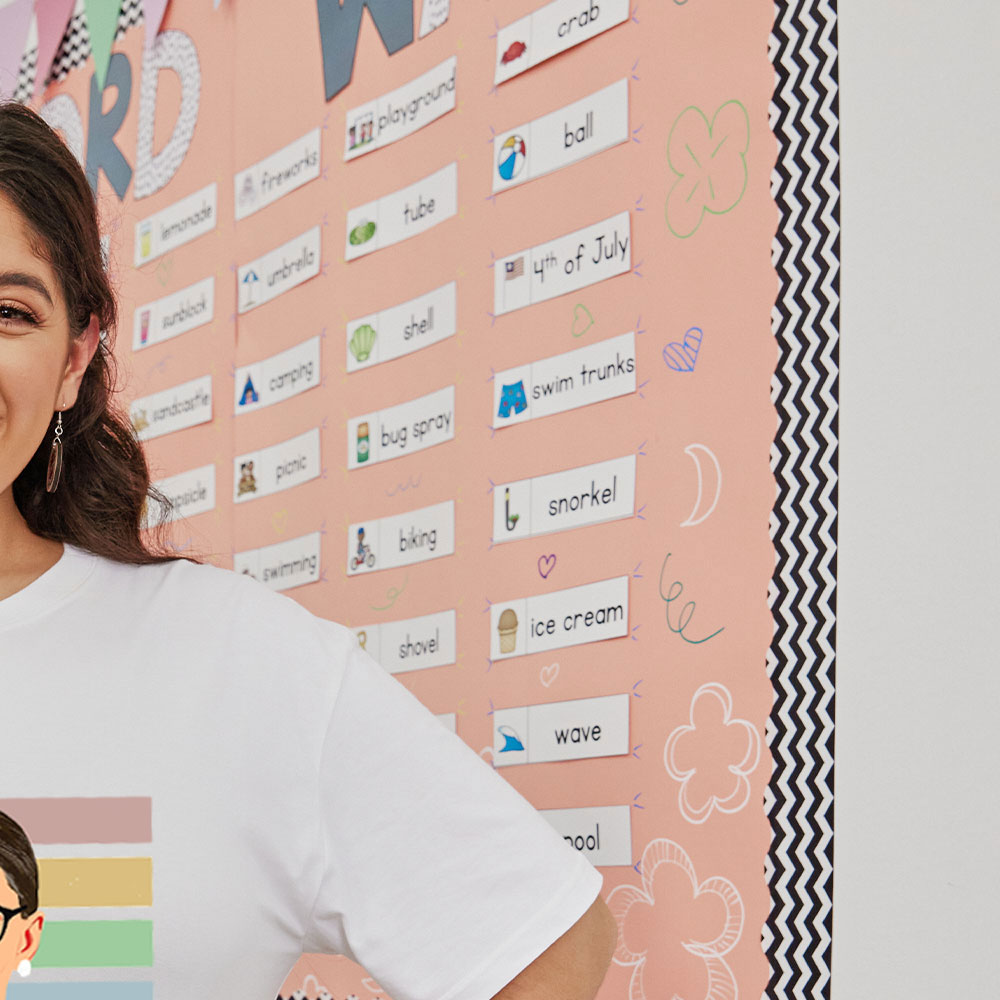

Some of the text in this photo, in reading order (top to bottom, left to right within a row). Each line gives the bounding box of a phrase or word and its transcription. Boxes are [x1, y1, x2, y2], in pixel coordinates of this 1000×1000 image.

[557, 0, 600, 37] crab
[377, 67, 458, 135] playground
[564, 111, 594, 149] ball
[261, 148, 318, 194] fireworks
[161, 200, 213, 240] lemonade
[404, 195, 435, 225] tube
[267, 247, 314, 287] umbrella
[564, 244, 585, 276] of
[591, 230, 629, 266] July
[162, 292, 206, 329] sunblock
[403, 306, 434, 341] shell
[269, 361, 313, 392] camping
[532, 352, 635, 400] swim trunks
[381, 411, 452, 448] bug spray
[275, 456, 306, 485] picnic
[548, 475, 617, 516] snorkel
[400, 526, 437, 552] biking
[263, 555, 317, 582] swimming
[531, 603, 624, 638] ice cream
[399, 628, 439, 658] shovel
[554, 724, 601, 745] wave
